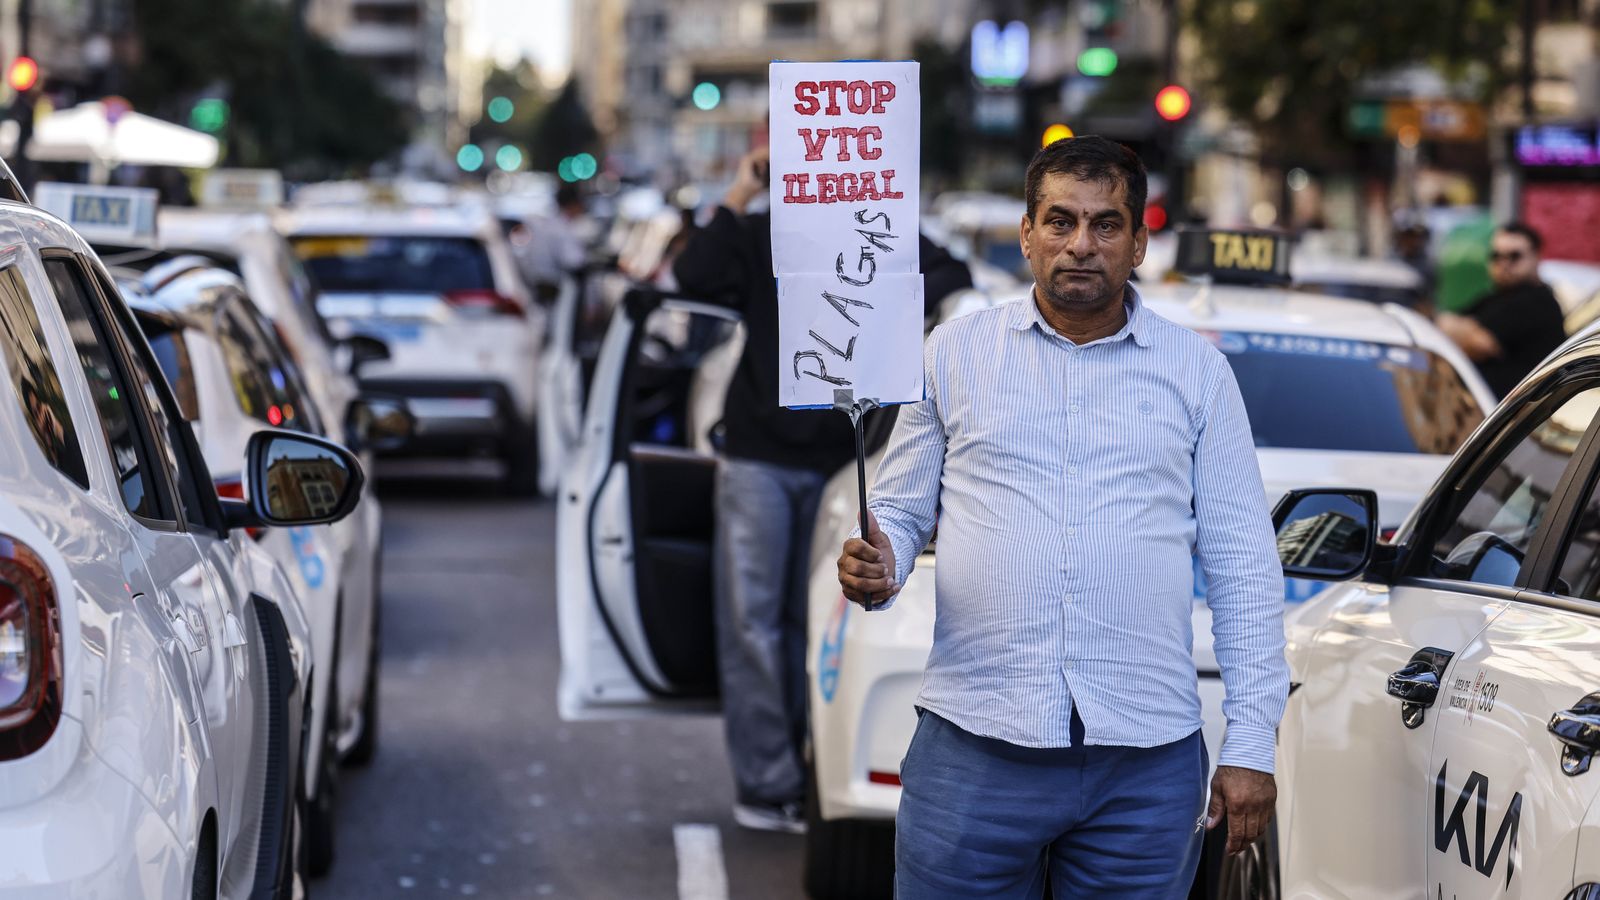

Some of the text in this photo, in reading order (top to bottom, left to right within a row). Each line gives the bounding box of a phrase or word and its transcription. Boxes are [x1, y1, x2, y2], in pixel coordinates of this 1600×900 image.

[794, 80, 896, 116] STOP
[797, 126, 882, 161] VTC
[783, 169, 904, 204] ILEGAL
[75, 195, 130, 225] TAXI
[1210, 233, 1274, 271] TAXI
[793, 208, 899, 386] PLAGAS
[1477, 682, 1499, 713] 1508
